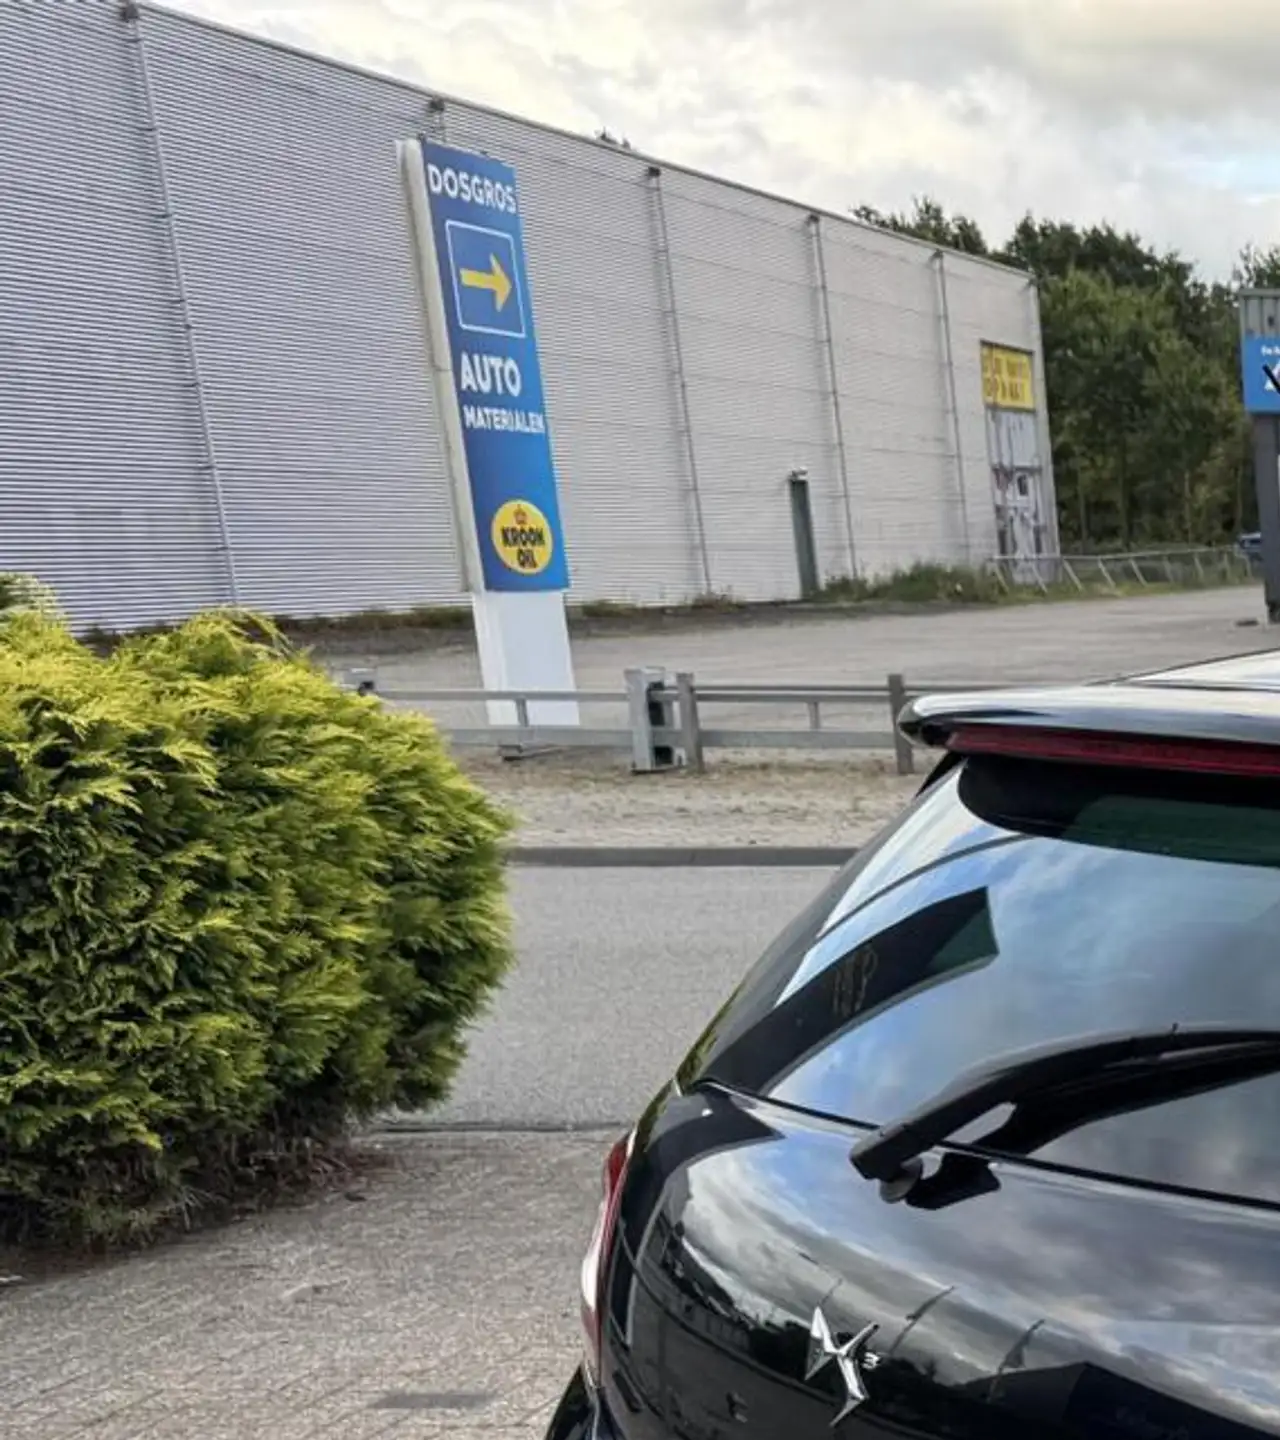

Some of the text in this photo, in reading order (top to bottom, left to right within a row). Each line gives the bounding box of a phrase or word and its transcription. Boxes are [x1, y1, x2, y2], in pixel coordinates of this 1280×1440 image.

[427, 163, 517, 214] DOSGROS
[460, 353, 522, 397] AUTO
[463, 405, 546, 434] MATERIALEN
[501, 525, 546, 547] KROON
[516, 548, 539, 569] OIL
